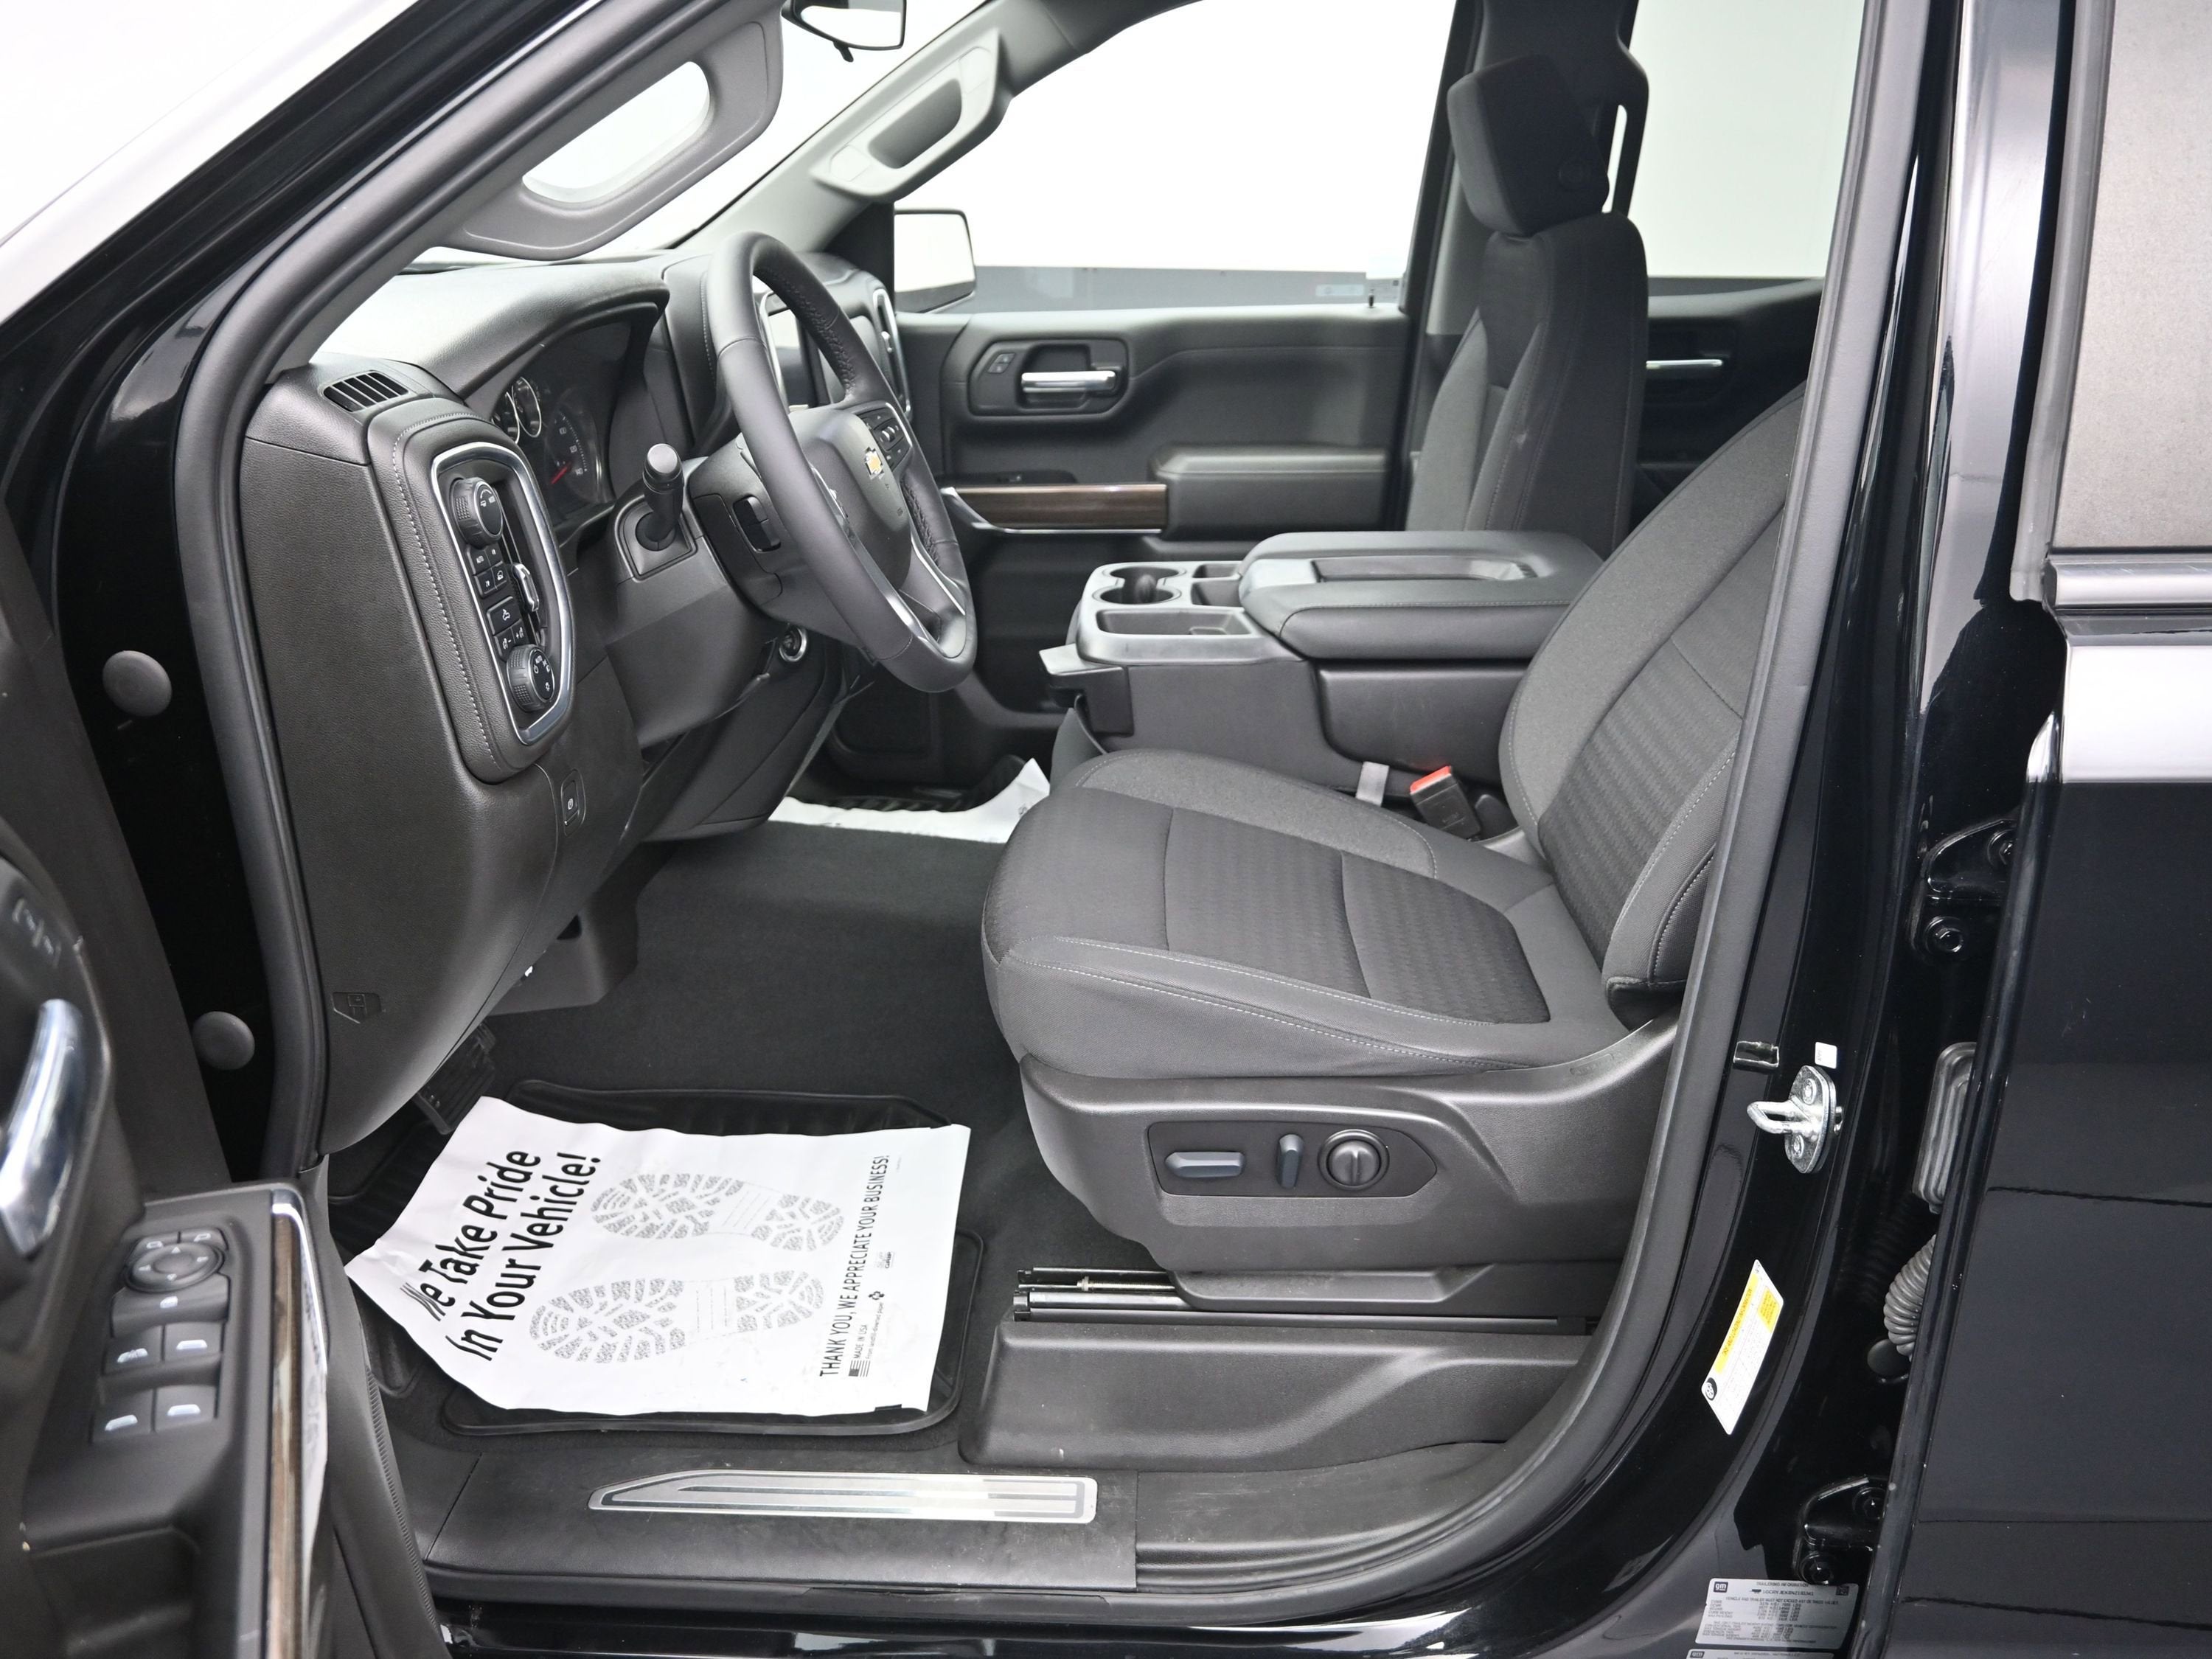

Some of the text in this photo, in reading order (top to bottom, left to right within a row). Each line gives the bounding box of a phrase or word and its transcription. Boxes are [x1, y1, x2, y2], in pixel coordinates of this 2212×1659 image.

[418, 1224, 498, 1284] Take
[462, 1150, 541, 1220] Pride
[445, 1152, 601, 1361] In Your Vehicle!
[819, 1155, 890, 1377] THANK YOU, WE APPRECIATE YOUR BUSINESS!
[854, 1343, 864, 1359] MADE
[1715, 1583, 1727, 1591] gm
